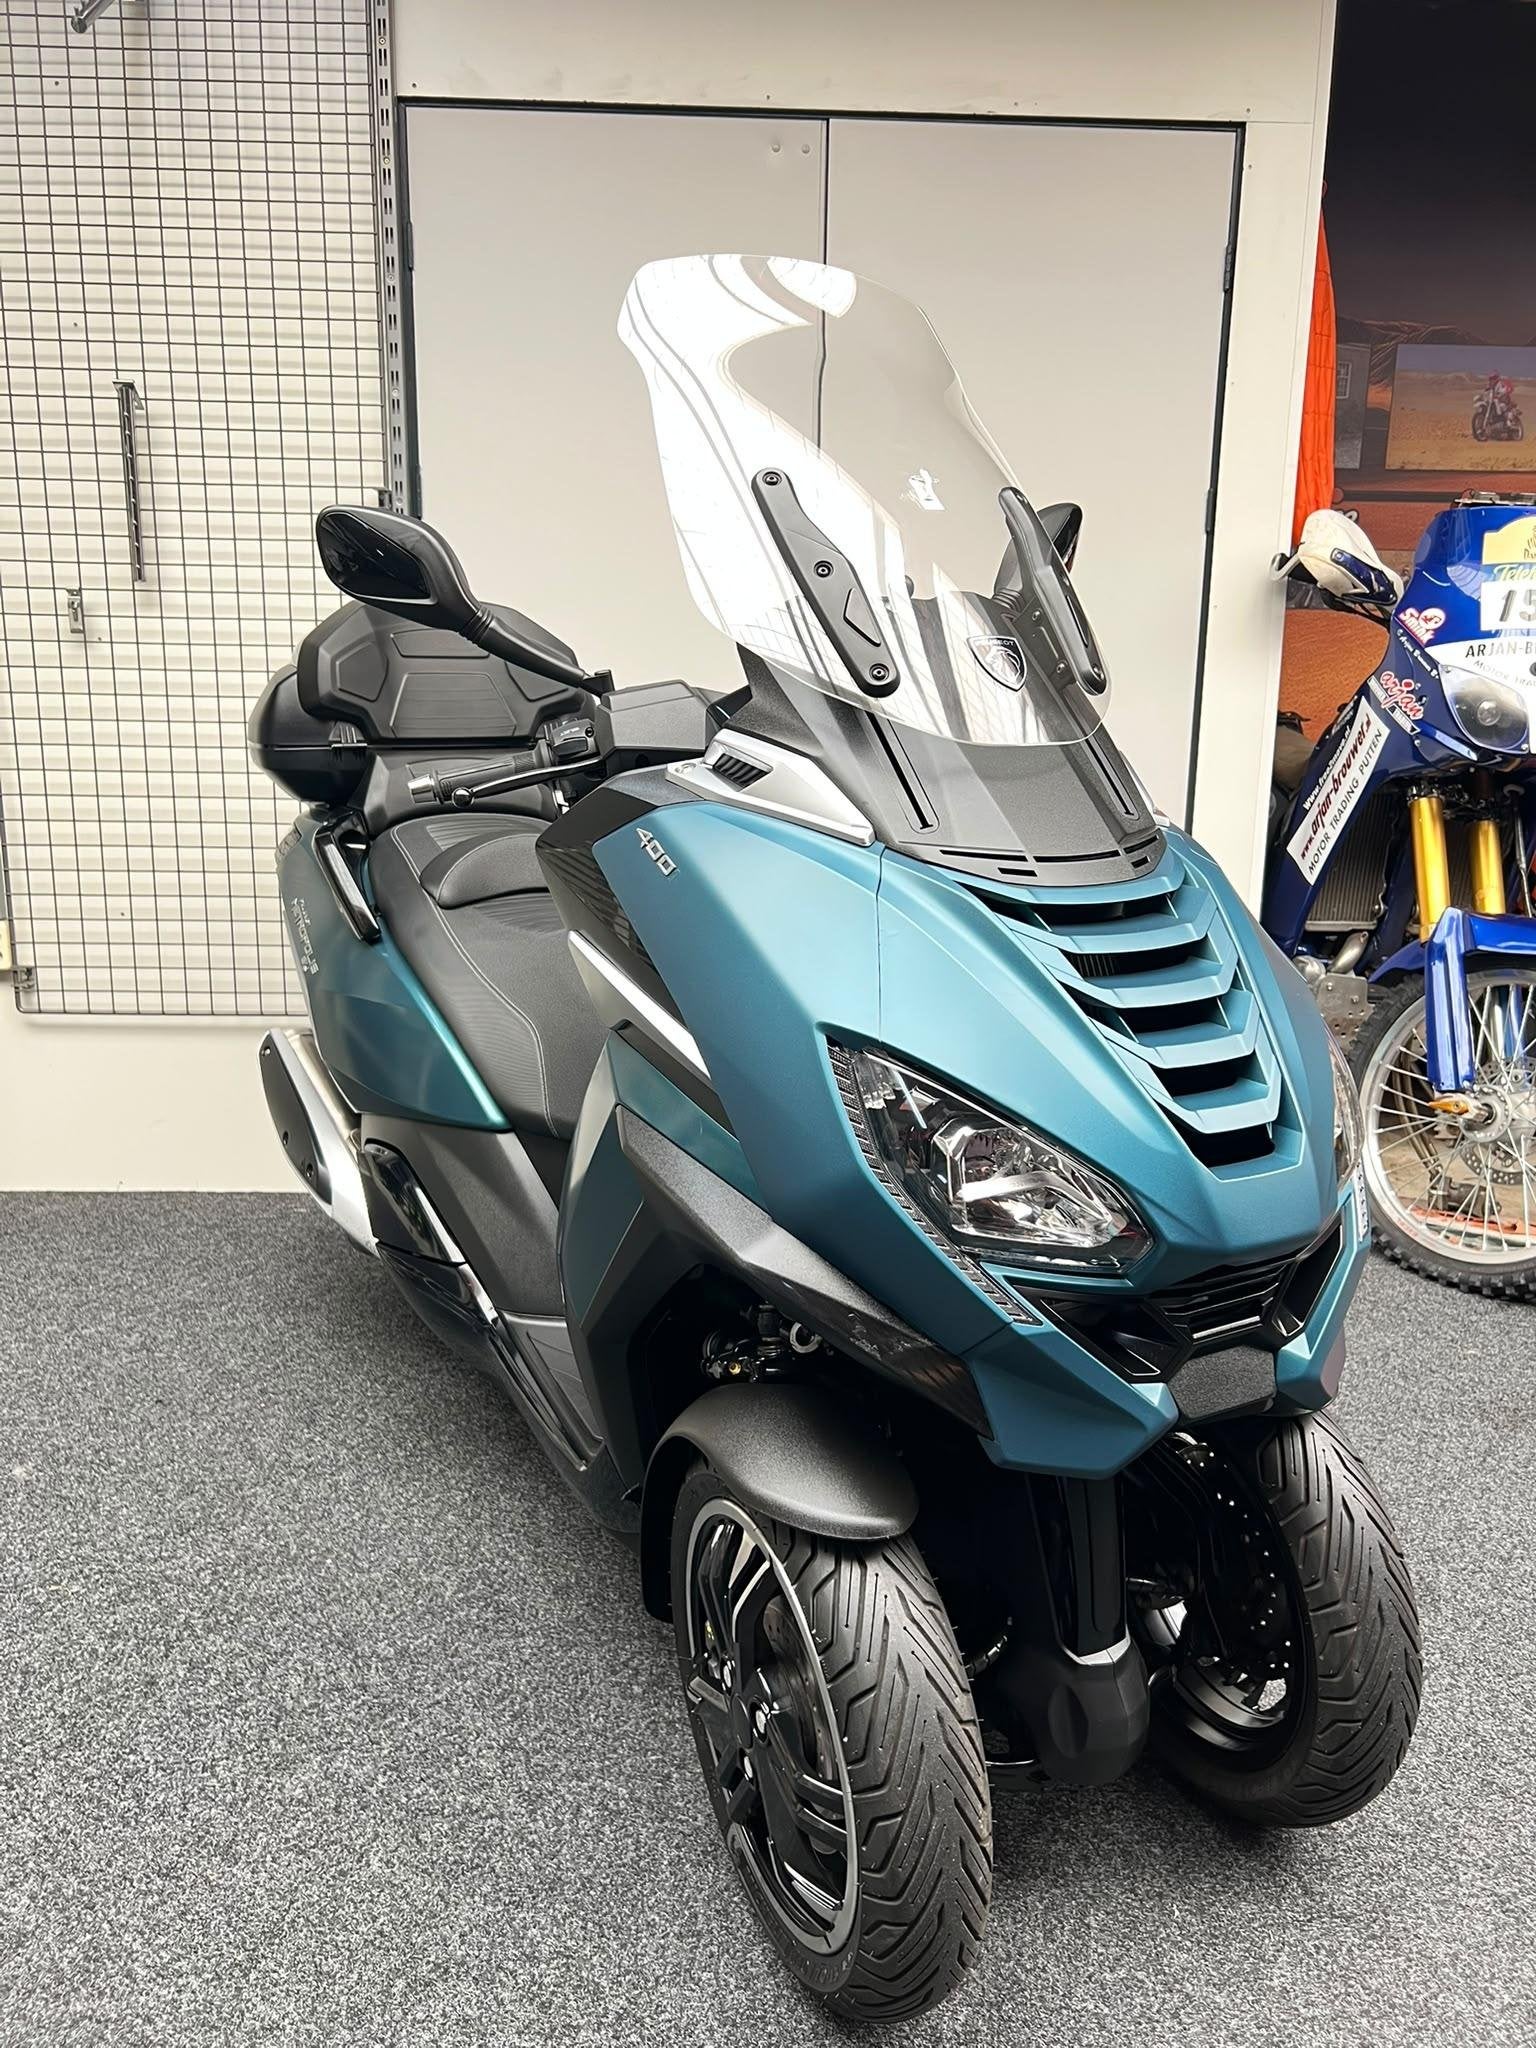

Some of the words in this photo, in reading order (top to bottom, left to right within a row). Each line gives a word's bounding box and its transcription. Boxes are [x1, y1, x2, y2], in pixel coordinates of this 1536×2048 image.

[1465, 641, 1536, 658] ARJAN-B
[1473, 660, 1510, 680] MOTOR
[1381, 671, 1424, 719] arjan
[1300, 712, 1372, 860] www.arjan-brouwer.nl
[1308, 832, 1331, 874] MOTOR
[1331, 778, 1360, 832] TRADING
[1359, 731, 1383, 774] PUTTEN
[636, 827, 677, 876] 400
